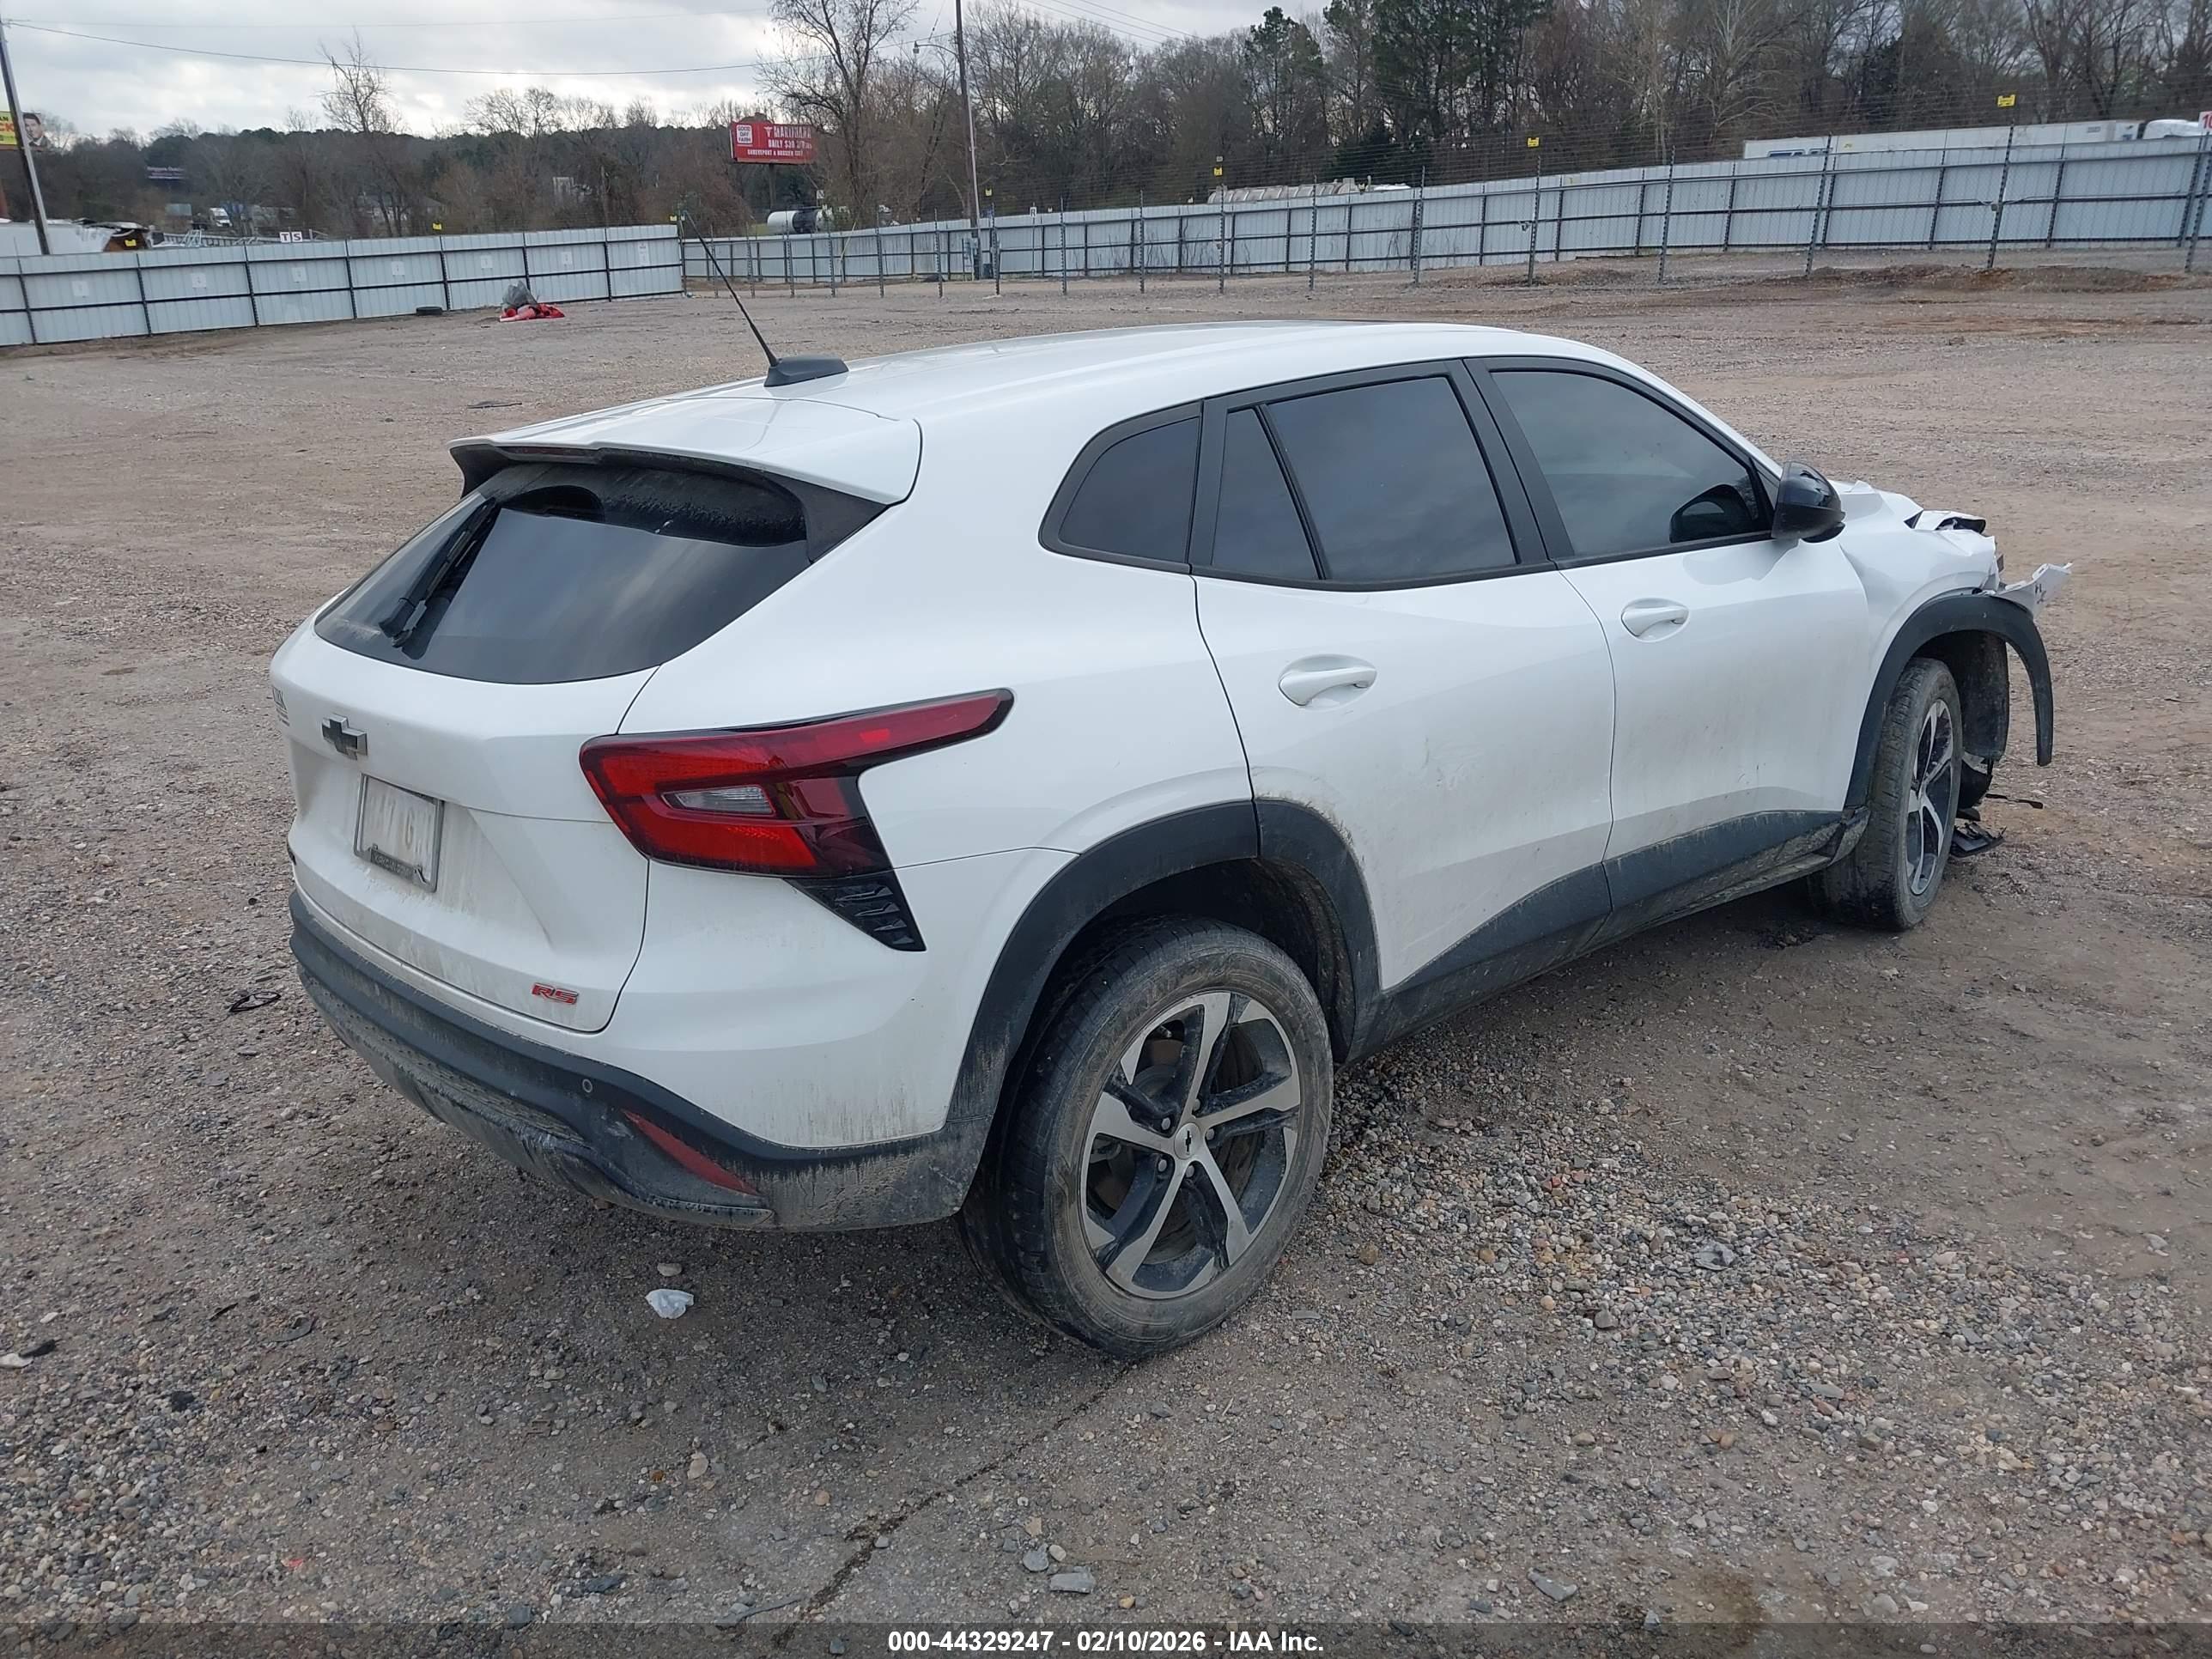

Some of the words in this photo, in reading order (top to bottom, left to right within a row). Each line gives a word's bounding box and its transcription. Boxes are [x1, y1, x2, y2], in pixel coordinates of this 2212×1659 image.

[769, 139, 783, 148] DAILY
[1030, 208, 1036, 217] R
[293, 233, 301, 241] S
[531, 982, 579, 1005] RS
